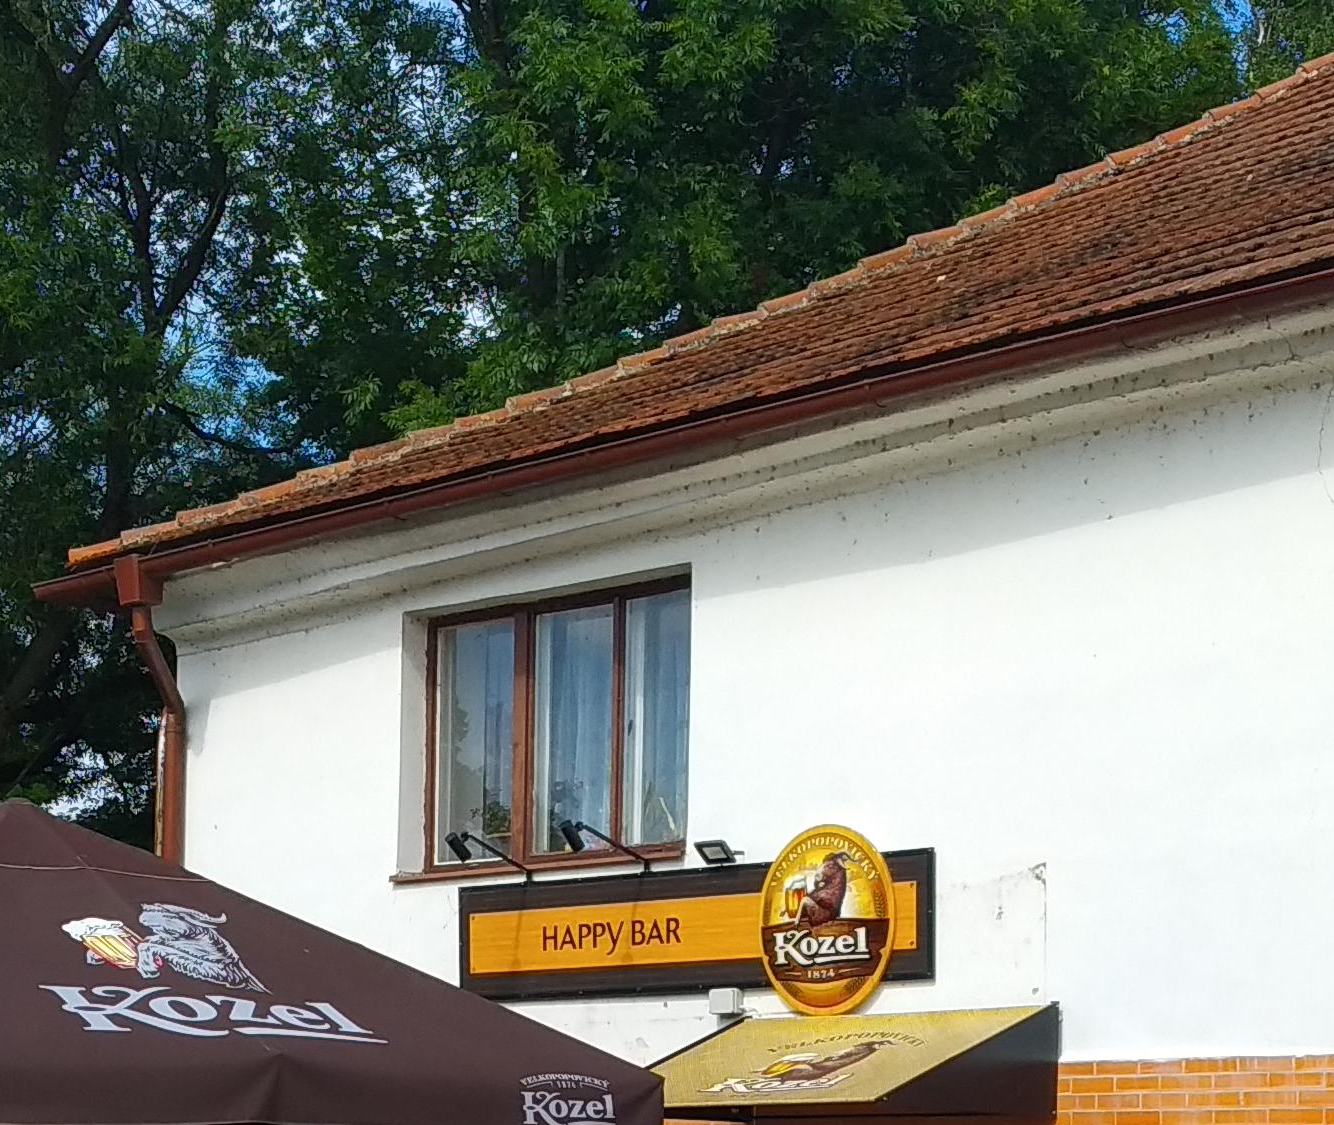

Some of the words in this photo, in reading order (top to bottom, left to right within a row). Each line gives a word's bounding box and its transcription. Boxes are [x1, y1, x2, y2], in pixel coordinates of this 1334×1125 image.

[770, 835, 880, 888] VELKOPOPOVICKÝ
[541, 921, 625, 955] HAPPY
[631, 916, 681, 948] BAR
[773, 926, 871, 966] Kozel
[807, 969, 835, 979] 1874
[38, 984, 376, 1037] Kozel
[519, 1073, 611, 1088] VELKOPOPOVICKÝ
[698, 1072, 855, 1093] Kozel
